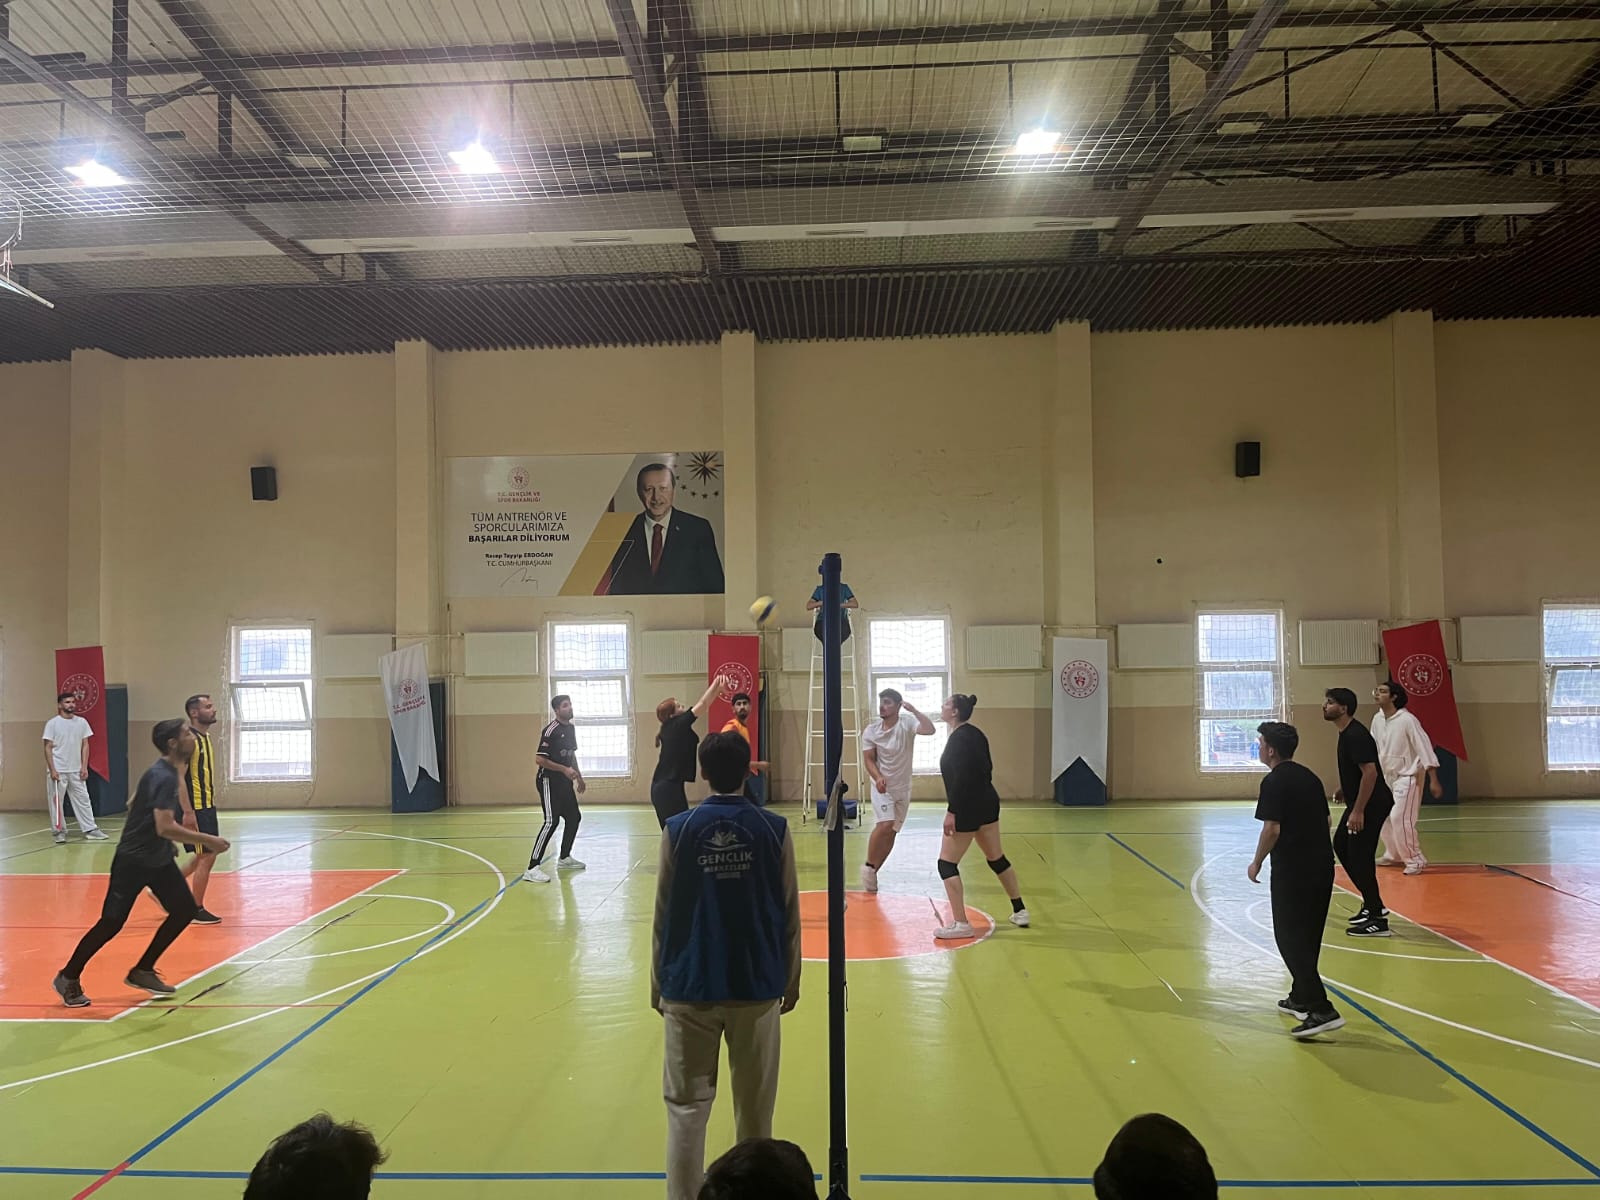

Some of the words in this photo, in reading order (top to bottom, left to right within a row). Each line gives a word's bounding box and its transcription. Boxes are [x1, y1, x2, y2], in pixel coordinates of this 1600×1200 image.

[471, 512, 494, 522] TÜM
[497, 511, 553, 521] ANTRENÖR
[555, 511, 567, 521] VE
[474, 522, 564, 533] SPORCULARIMIZA
[468, 535, 518, 544] BAŞARILAR
[520, 533, 570, 542] DİLİYORUM
[485, 552, 503, 560] Recep
[697, 851, 752, 865] GENÇLİK
